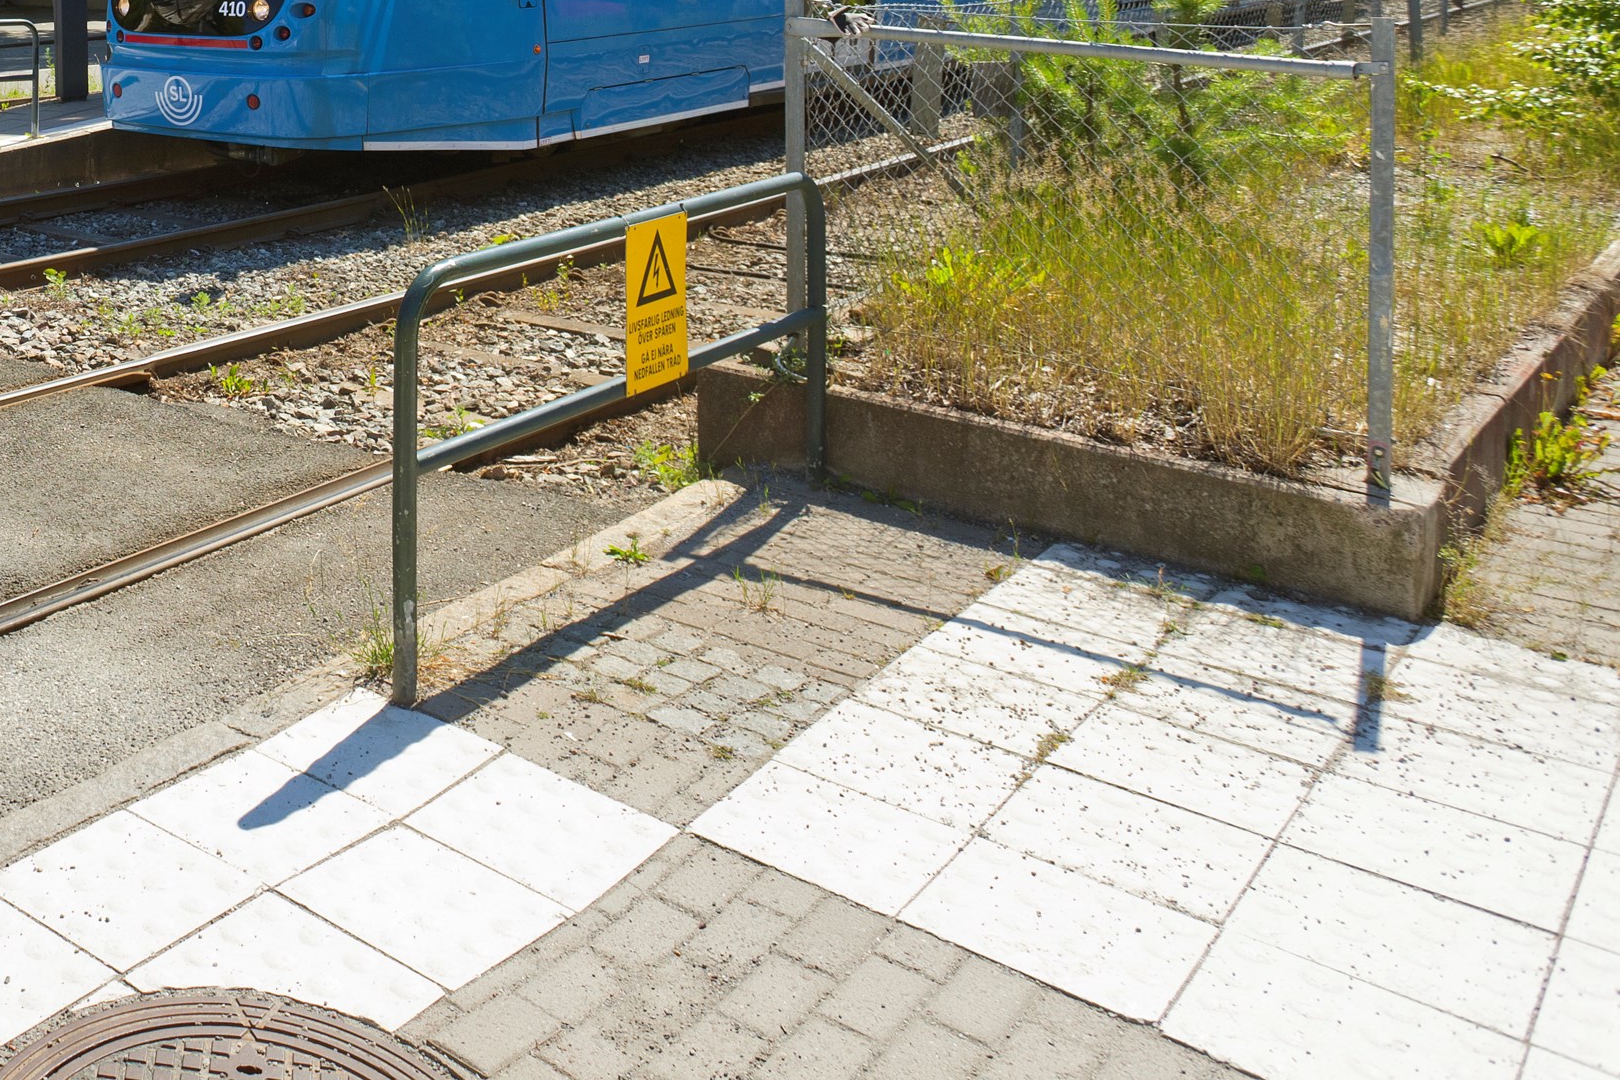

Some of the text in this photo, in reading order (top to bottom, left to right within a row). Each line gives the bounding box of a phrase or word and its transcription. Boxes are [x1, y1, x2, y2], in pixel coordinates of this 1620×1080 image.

[218, 0, 246, 17] 410
[169, 85, 187, 103] SL
[629, 306, 684, 334] LIVSFARLIG LEDNING
[638, 322, 676, 345] ÖVER SPÅREN
[658, 344, 674, 358] NÄRA
[634, 360, 665, 381] NEDFALLEN
